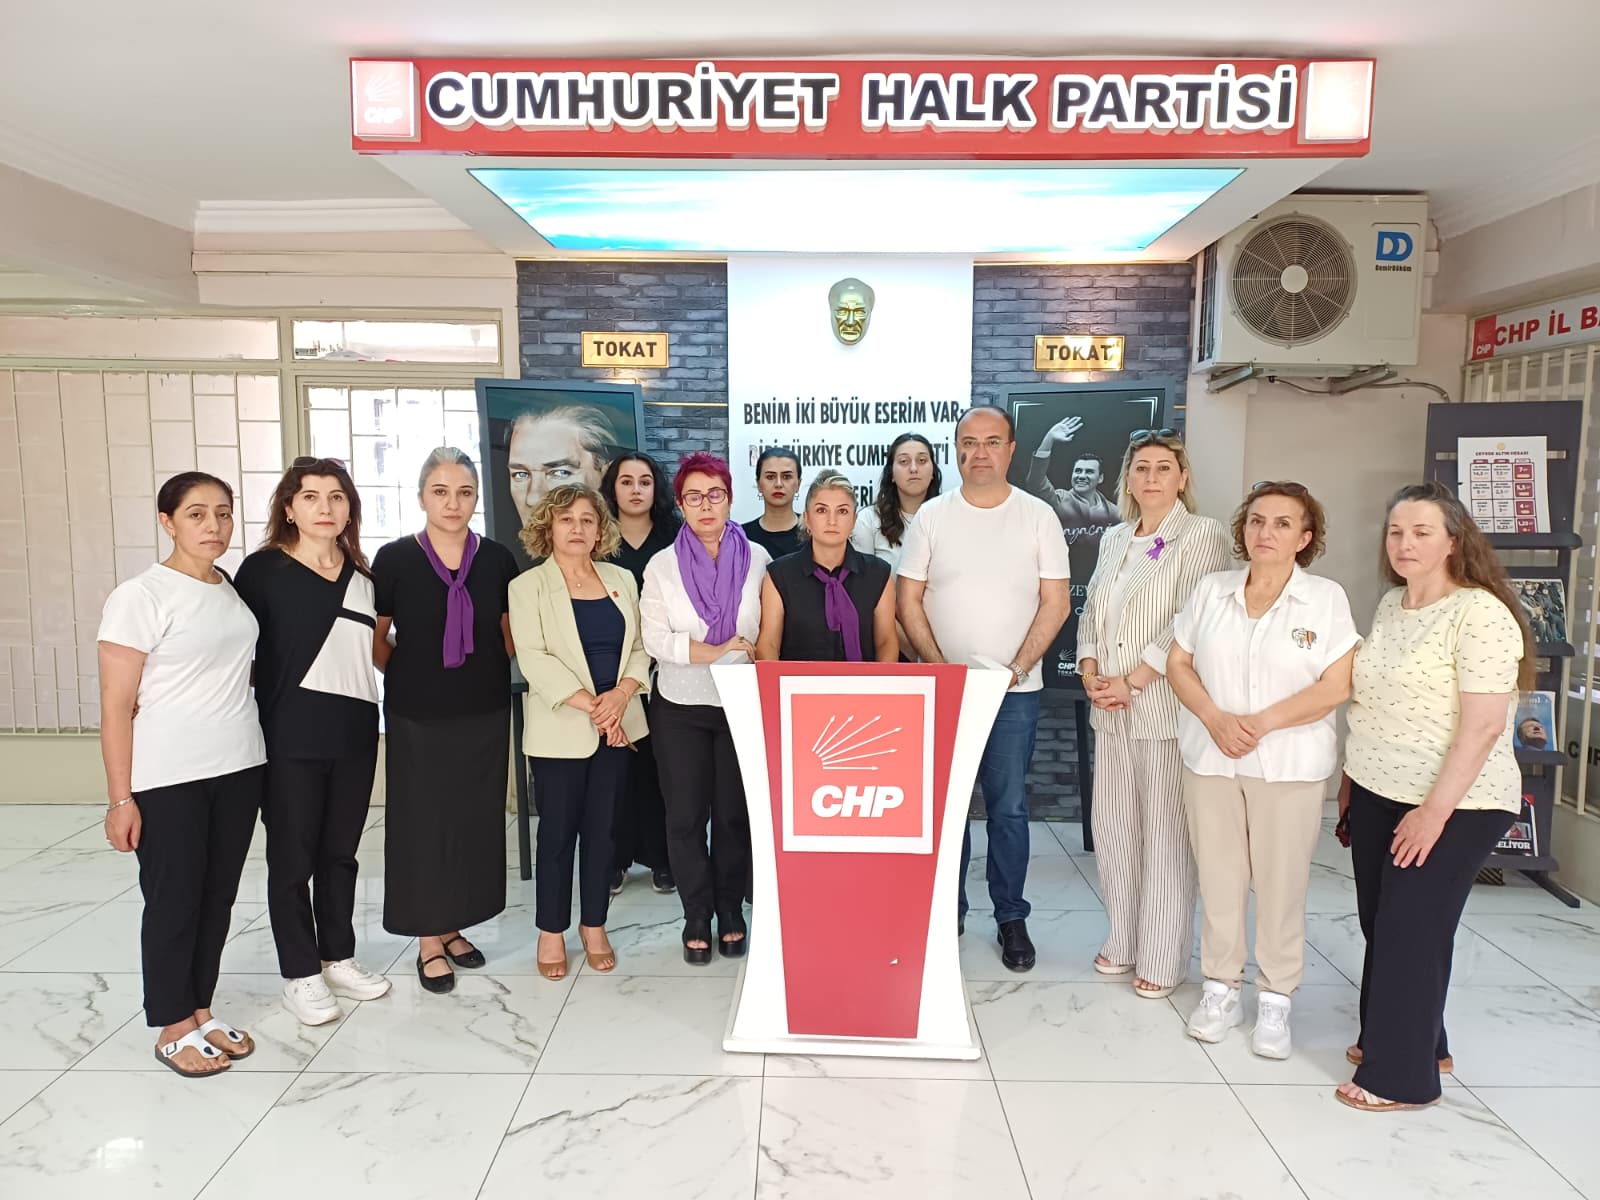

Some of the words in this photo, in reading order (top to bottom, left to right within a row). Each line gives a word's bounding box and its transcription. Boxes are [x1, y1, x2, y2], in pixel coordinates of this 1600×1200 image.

[426, 64, 838, 122] CUMHURİYET
[865, 76, 1034, 124] HALK
[1054, 67, 1296, 125] PARTİSİ
[1495, 319, 1540, 347] CHP
[1548, 309, 1571, 336] İL
[1580, 306, 1600, 330] B
[593, 341, 657, 358] TOKAT
[1046, 345, 1114, 361] TOKAT
[743, 396, 791, 425] BENİM
[796, 396, 816, 425] İKİ
[820, 396, 870, 425] BÜYÜK
[875, 395, 926, 424] ESERİM
[782, 438, 842, 466] ÜRKİYE
[811, 784, 905, 818] CHP
[1495, 839, 1531, 850] ELİYOR
